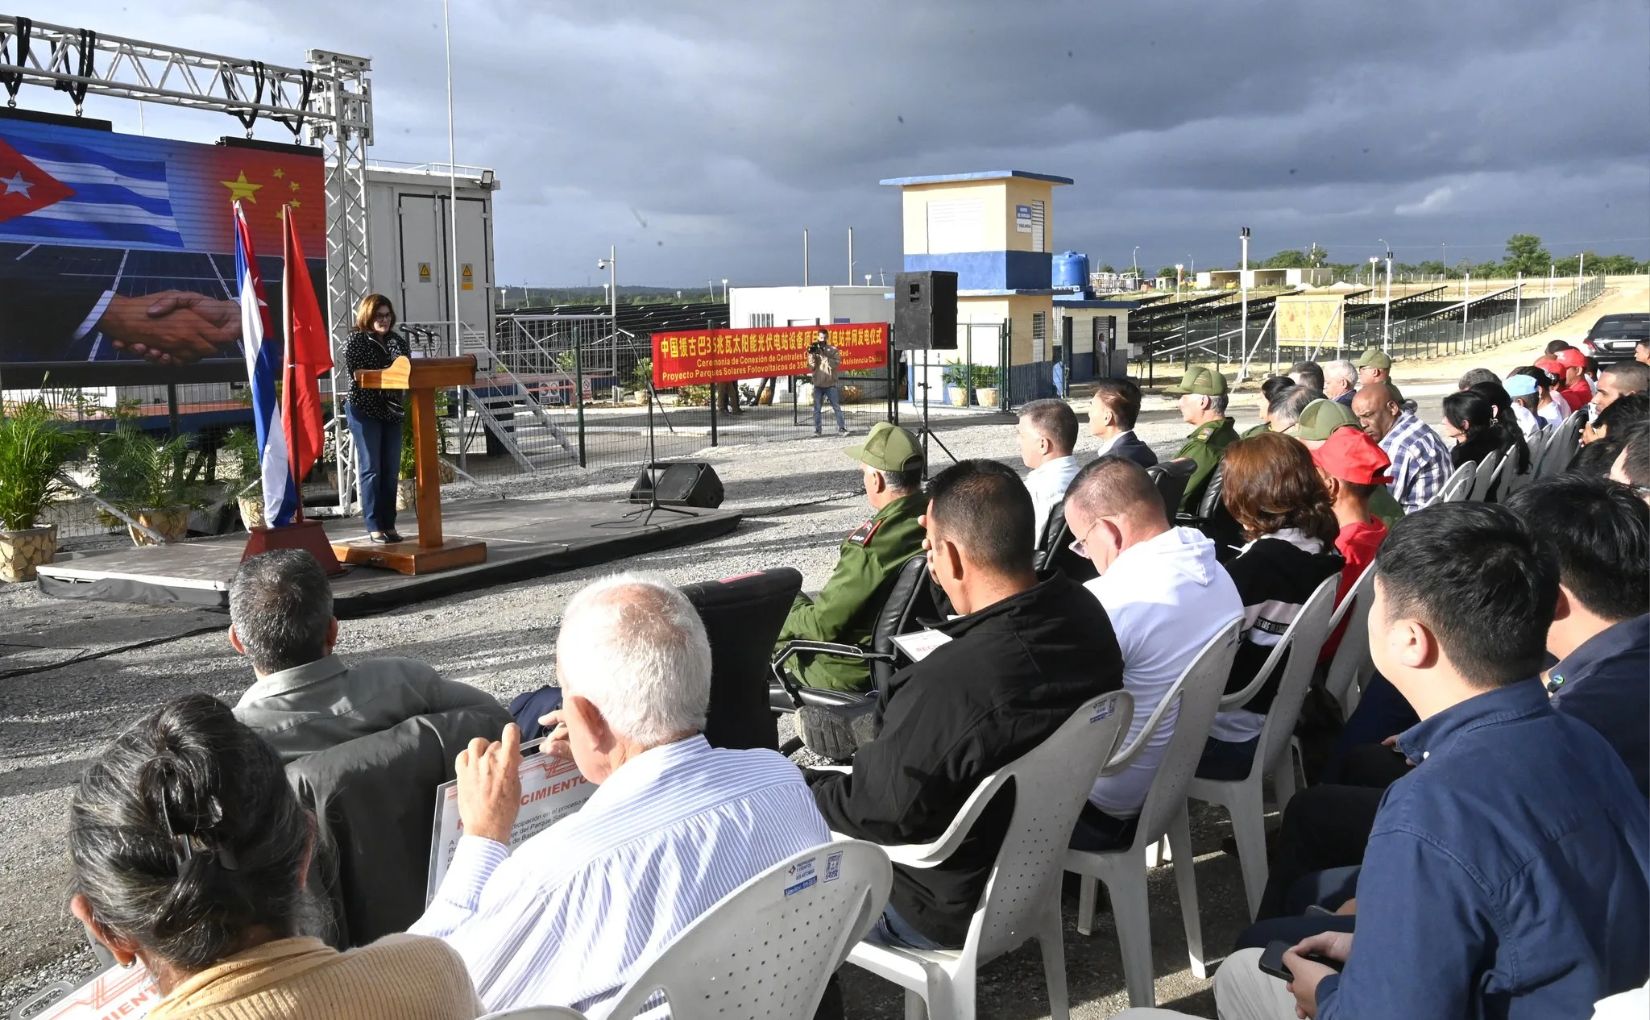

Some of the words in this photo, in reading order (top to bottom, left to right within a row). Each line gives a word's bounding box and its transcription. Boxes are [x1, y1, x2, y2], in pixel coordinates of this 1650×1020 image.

[696, 356, 731, 368] Ceremonia
[731, 356, 739, 366] de
[740, 354, 768, 365] Conexión
[768, 354, 776, 362] de
[776, 352, 803, 362] Centrales
[662, 370, 694, 382] Proyecto
[694, 368, 723, 379] Parques
[723, 366, 747, 375] Solares
[747, 362, 788, 374] Fotovoltaicos
[788, 362, 796, 370] de
[520, 775, 588, 806] CIMIENTO
